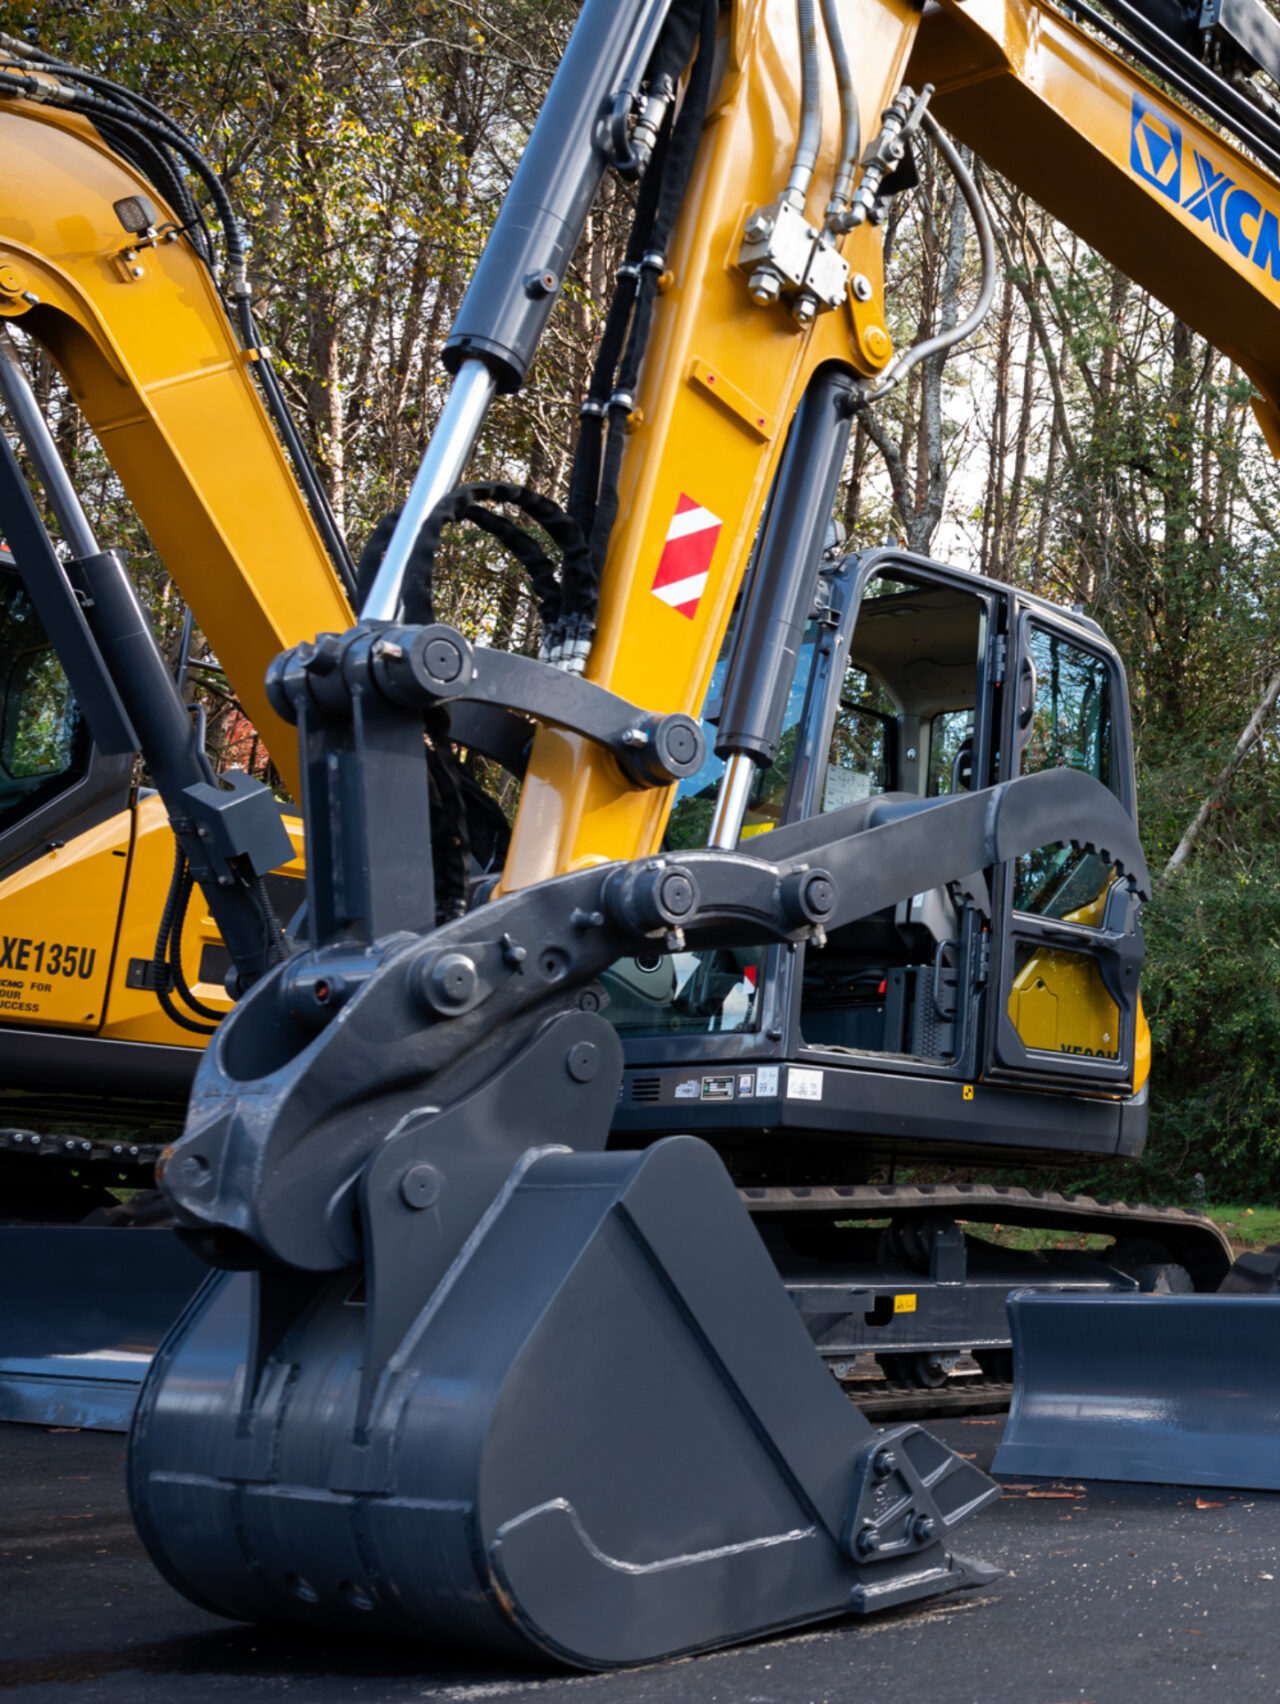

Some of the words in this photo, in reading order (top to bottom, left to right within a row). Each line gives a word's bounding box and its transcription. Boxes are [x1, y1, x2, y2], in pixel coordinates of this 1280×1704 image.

[0, 936, 96, 980] XE135U
[0, 979, 24, 989] CMG
[30, 981, 52, 993] FOR
[0, 989, 21, 1000] OUR
